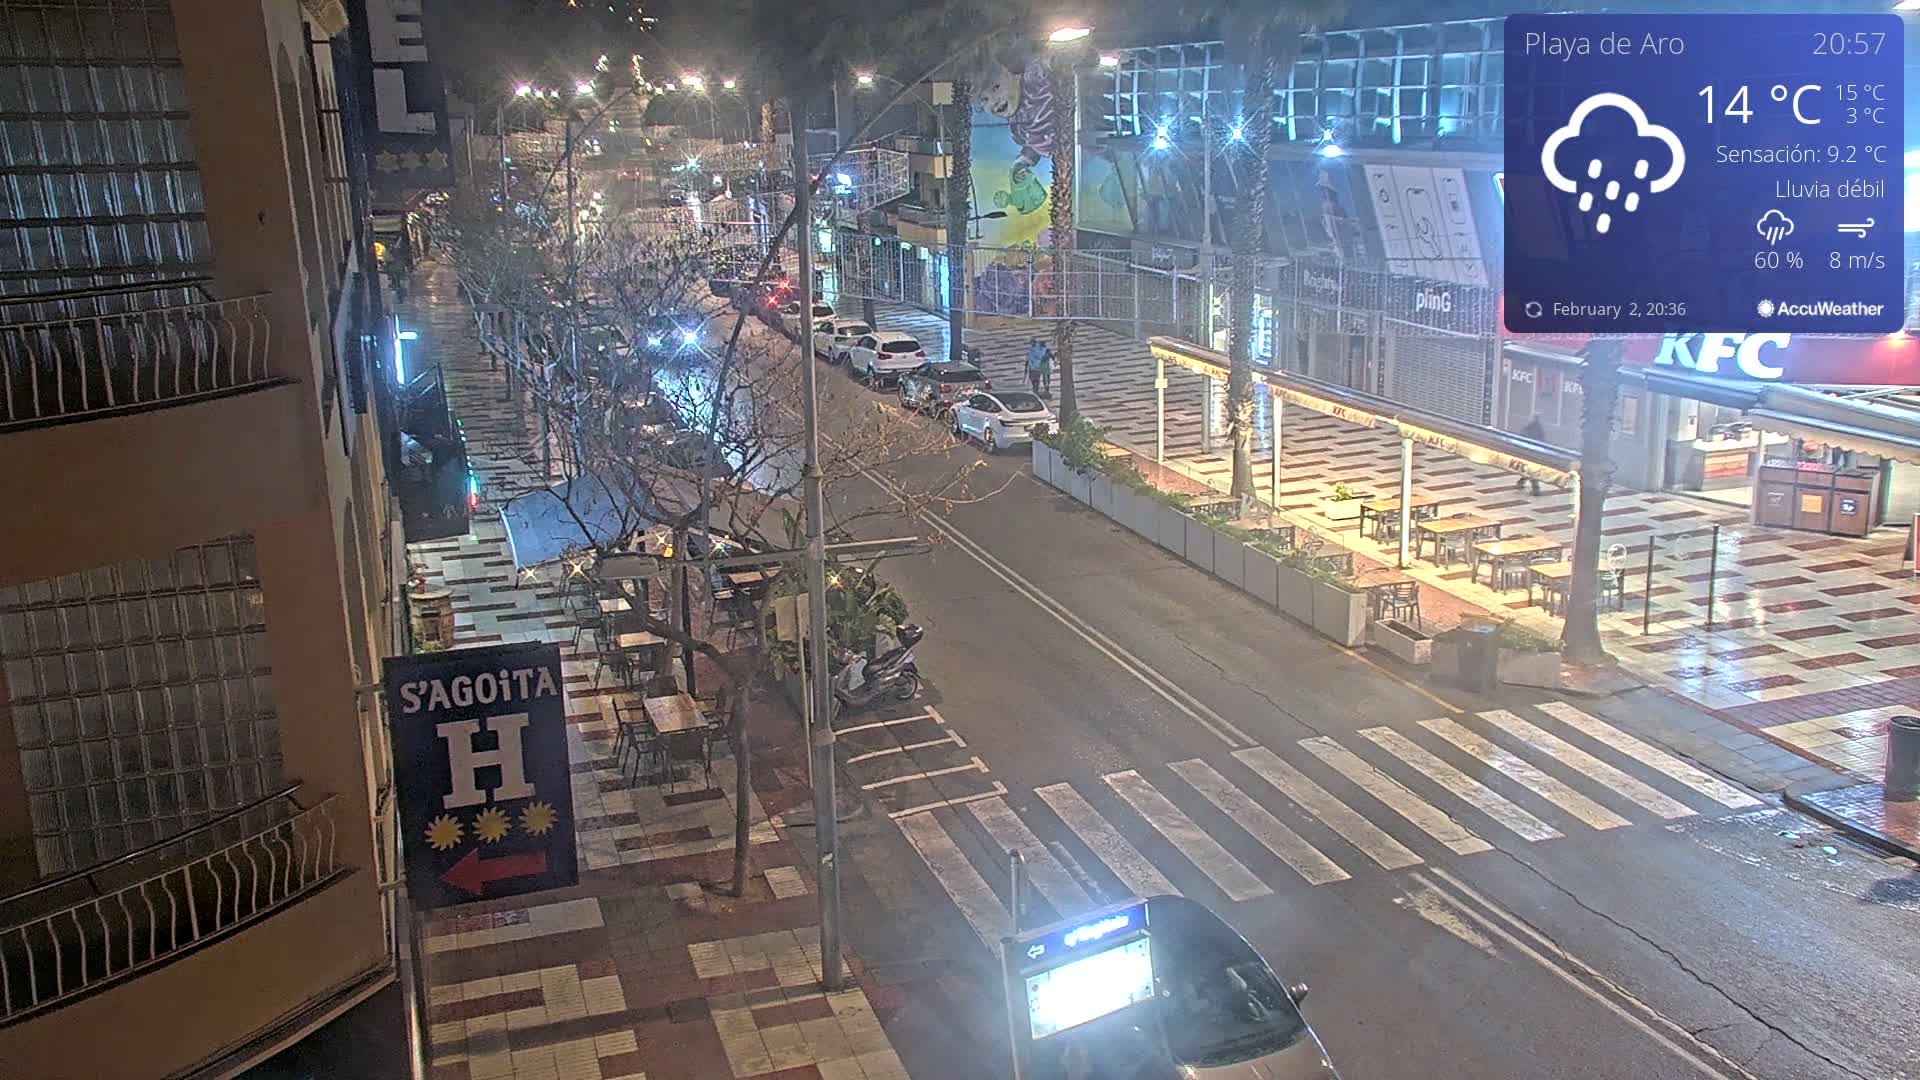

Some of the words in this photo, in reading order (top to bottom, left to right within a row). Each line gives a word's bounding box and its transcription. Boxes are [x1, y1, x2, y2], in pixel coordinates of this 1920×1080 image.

[1655, 333, 1792, 378] KFC
[1511, 368, 1533, 384] KFC
[1332, 406, 1347, 418] KFC
[1428, 435, 1446, 448] KFC
[1508, 458, 1528, 473] KFC
[436, 712, 536, 810] H
